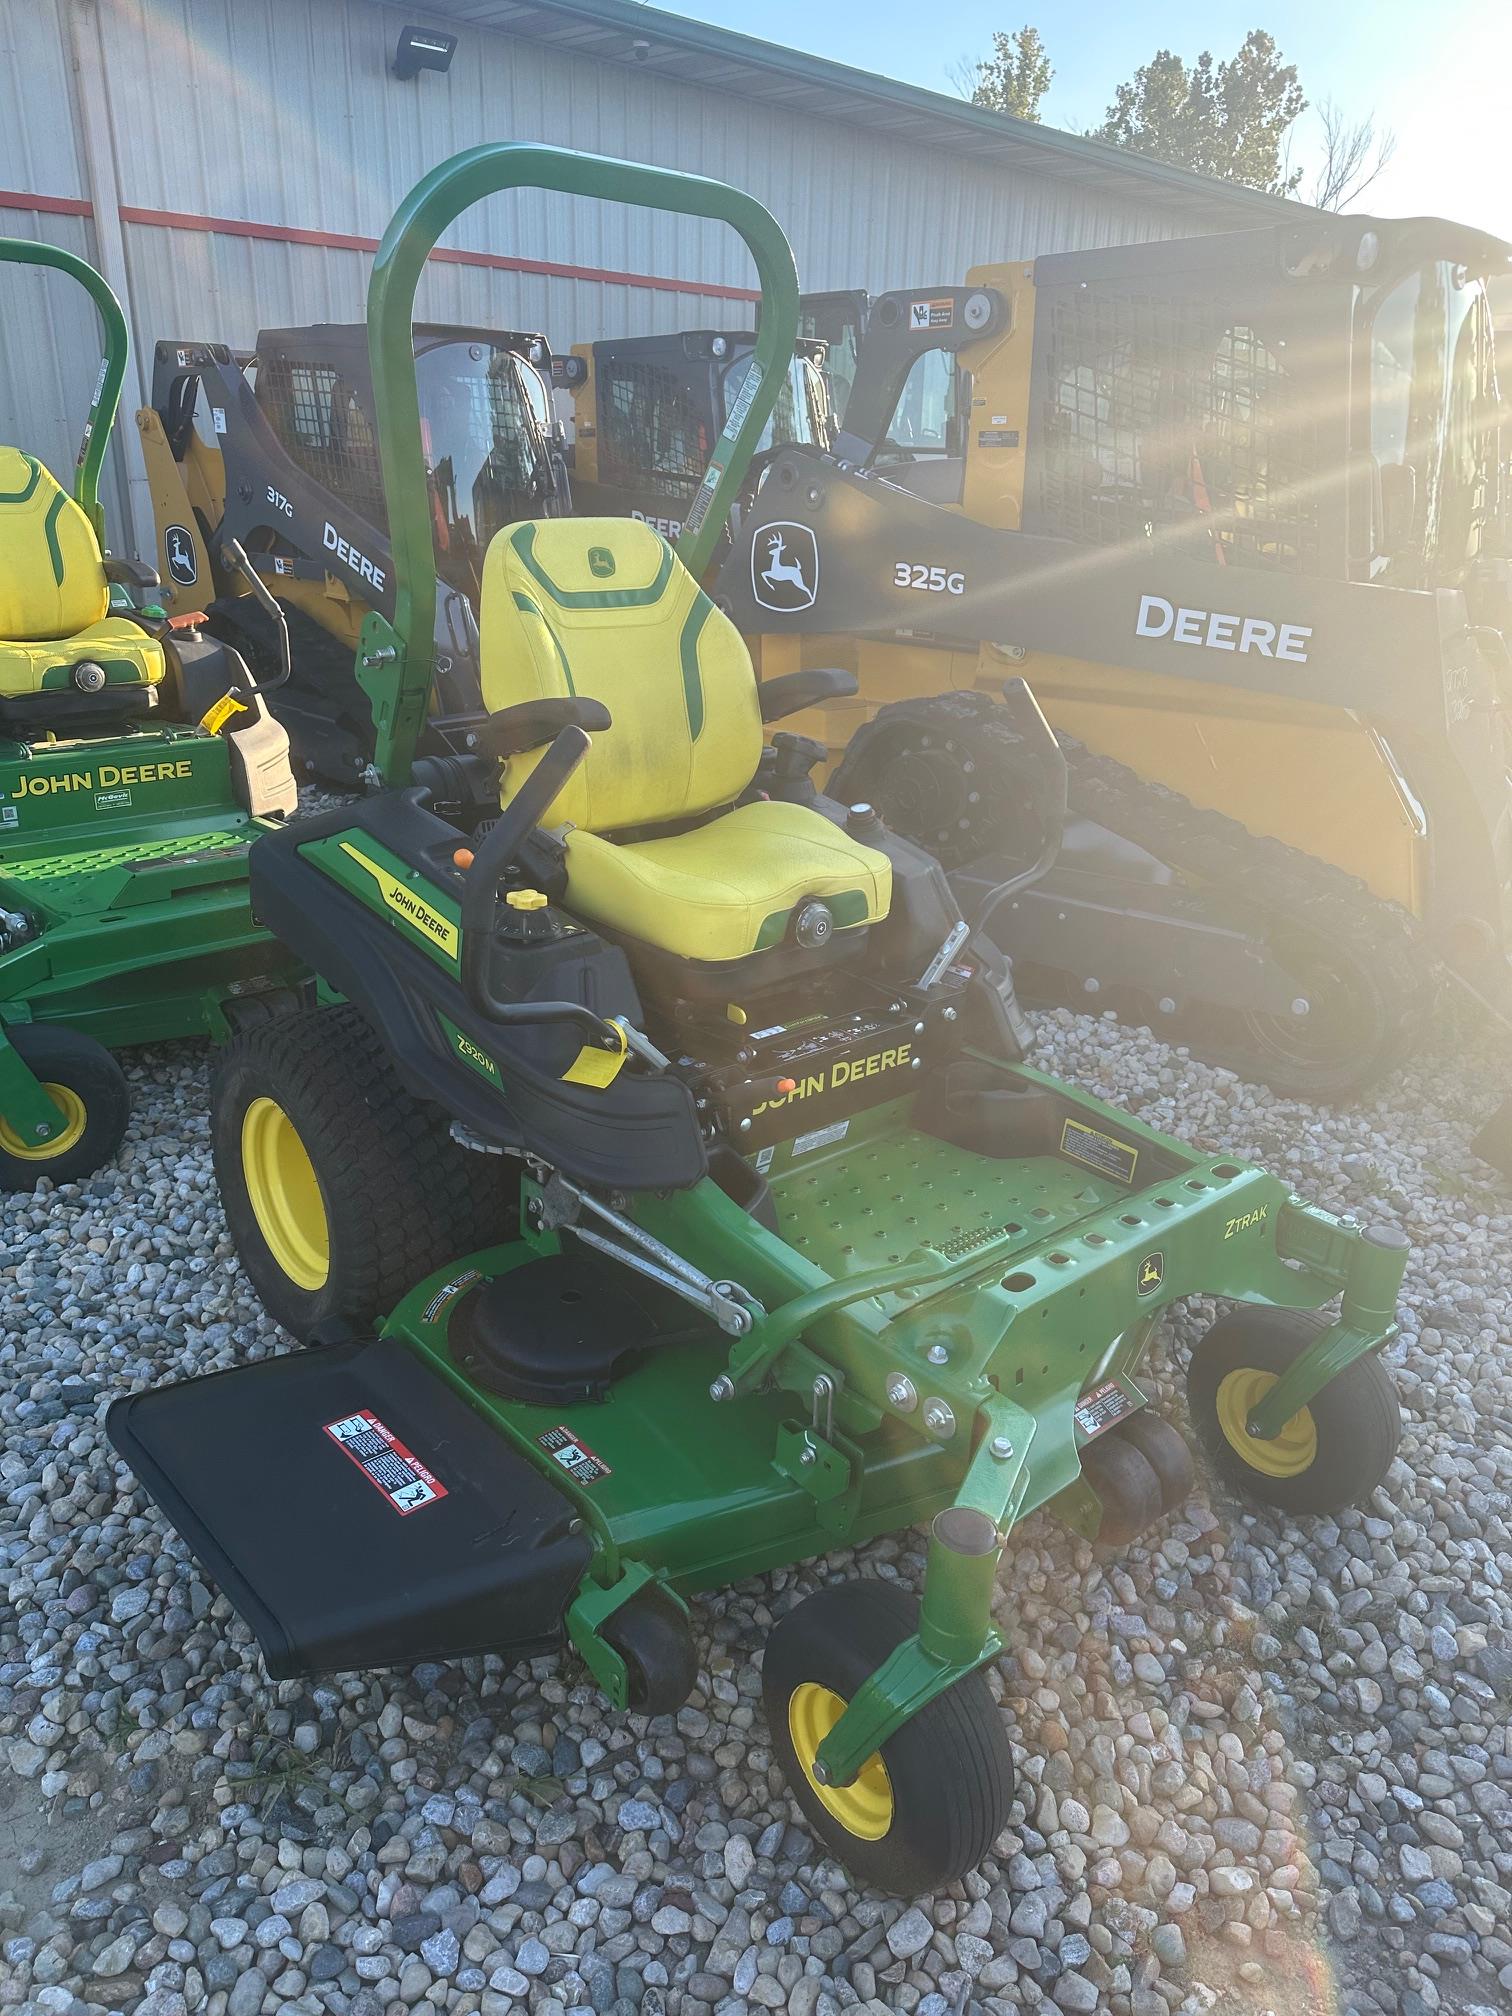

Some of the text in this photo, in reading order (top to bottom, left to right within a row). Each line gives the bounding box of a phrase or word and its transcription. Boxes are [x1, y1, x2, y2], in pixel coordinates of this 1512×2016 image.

[266, 485, 294, 518] 317G
[323, 521, 387, 593] DEERE
[893, 562, 965, 595] 325G
[1136, 595, 1313, 663] DEERE
[11, 760, 193, 799] JOHN DEERE
[389, 887, 450, 941] JOHN DEERE
[456, 1034, 495, 1075] Z920M
[831, 1043, 912, 1089] DEERE
[1224, 1203, 1268, 1240] ZTRAK
[372, 1422, 396, 1443] DANGER
[410, 1460, 436, 1485] PELIGRO
